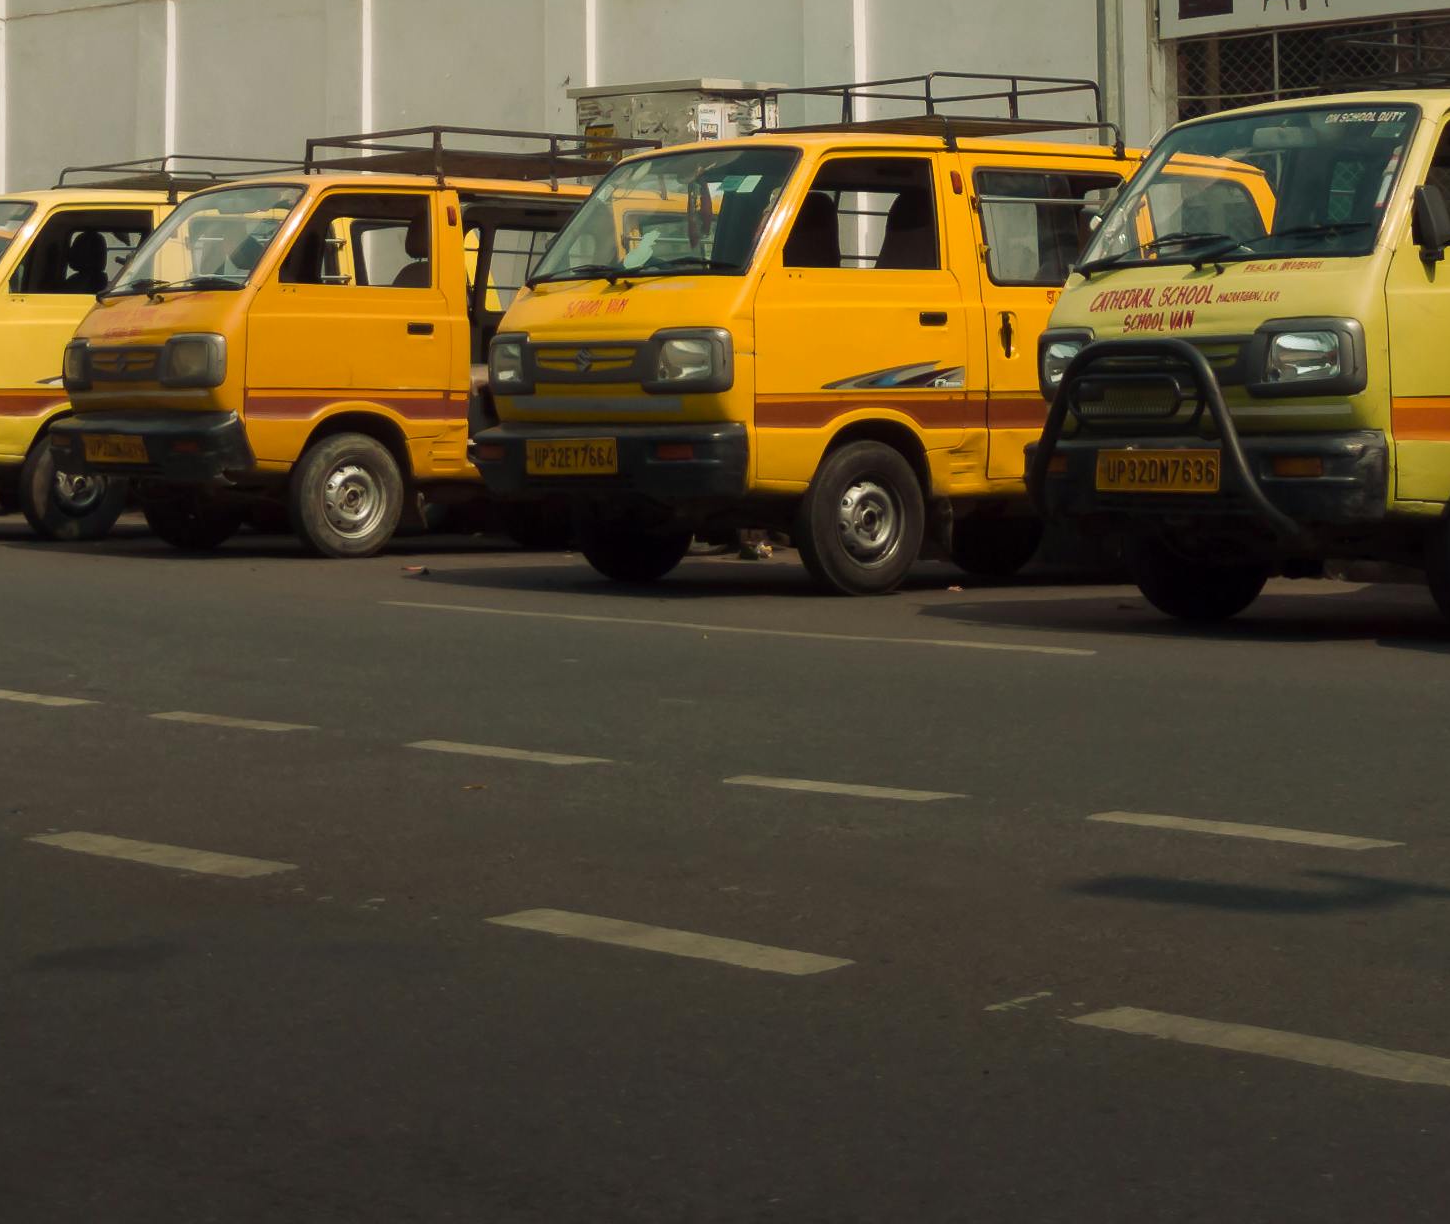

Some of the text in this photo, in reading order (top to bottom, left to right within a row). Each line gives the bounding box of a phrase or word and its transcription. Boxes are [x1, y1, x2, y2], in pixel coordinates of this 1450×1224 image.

[1089, 287, 1156, 312] CATHEDRAL
[1158, 284, 1214, 308] SCHOOL
[1123, 310, 1196, 334] SCHOOL VAN
